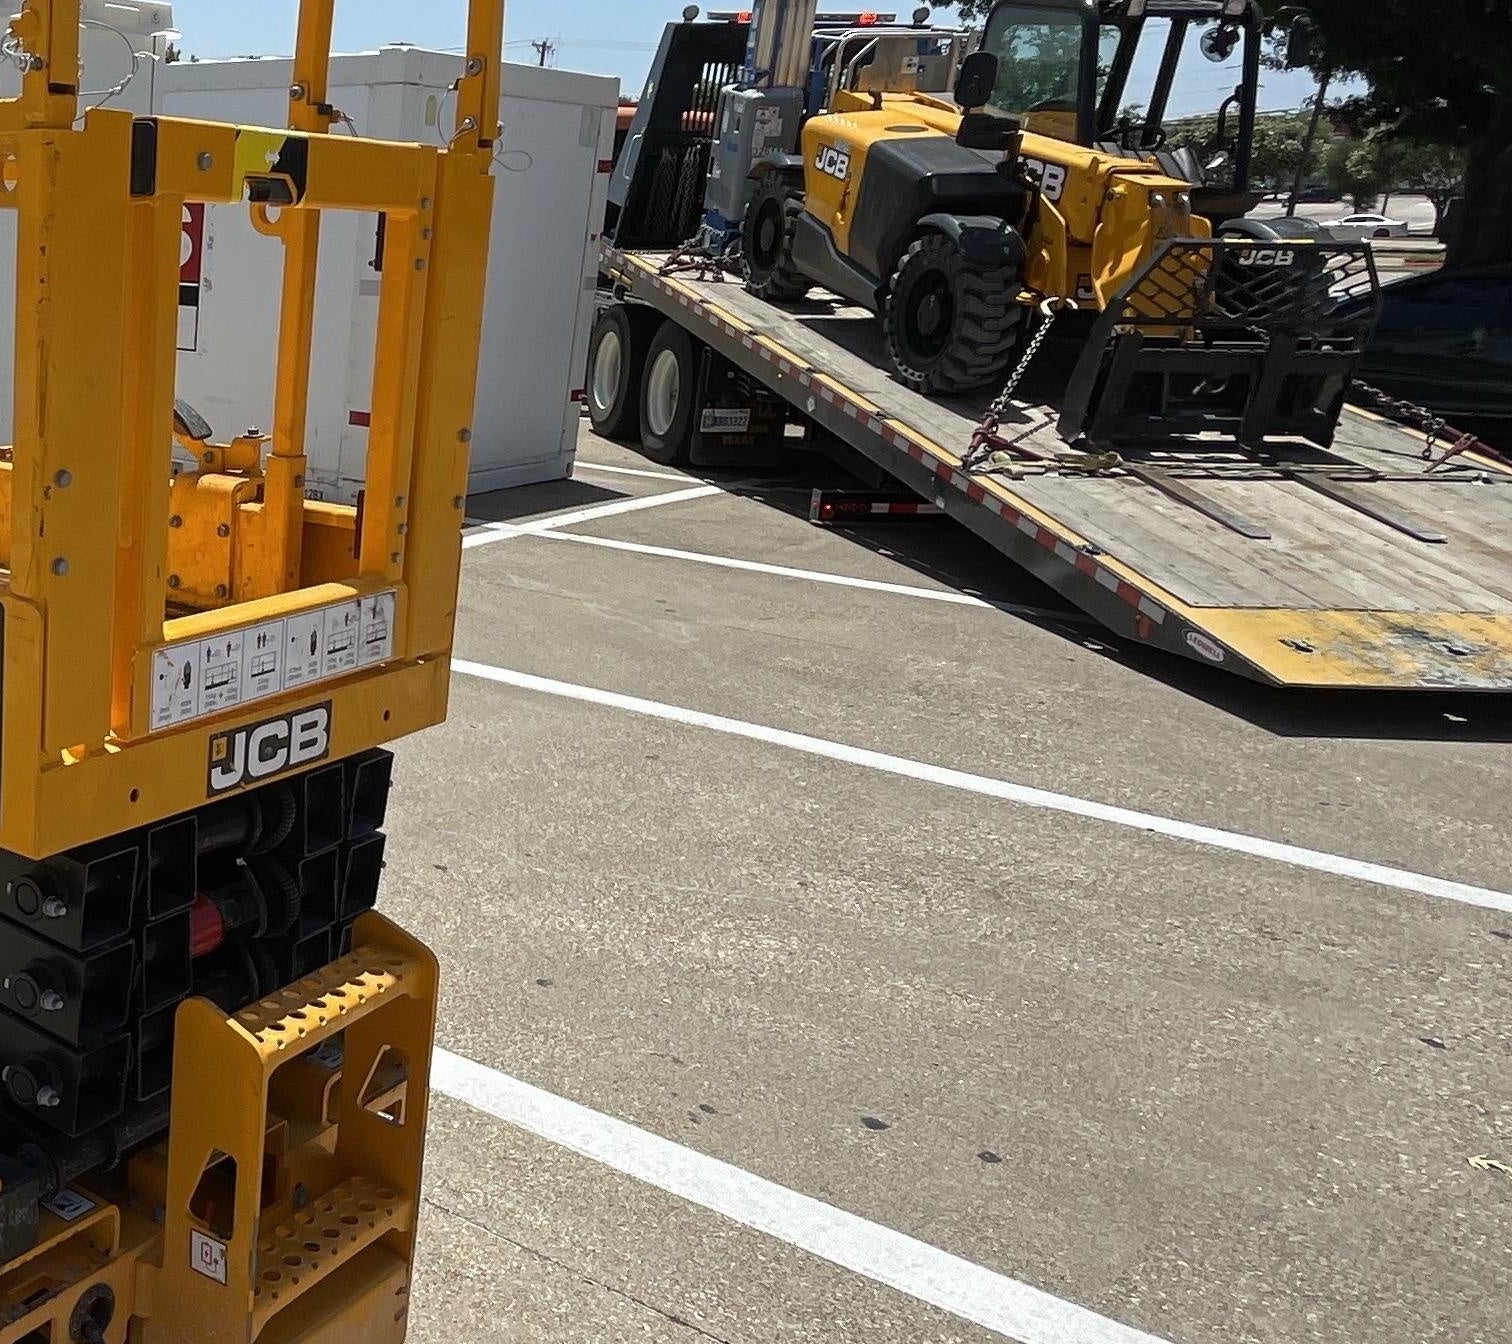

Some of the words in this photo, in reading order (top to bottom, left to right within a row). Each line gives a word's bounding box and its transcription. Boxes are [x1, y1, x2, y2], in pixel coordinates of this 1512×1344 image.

[815, 146, 850, 180] JCB
[1238, 249, 1295, 266] JCB
[210, 706, 329, 791] JCB
